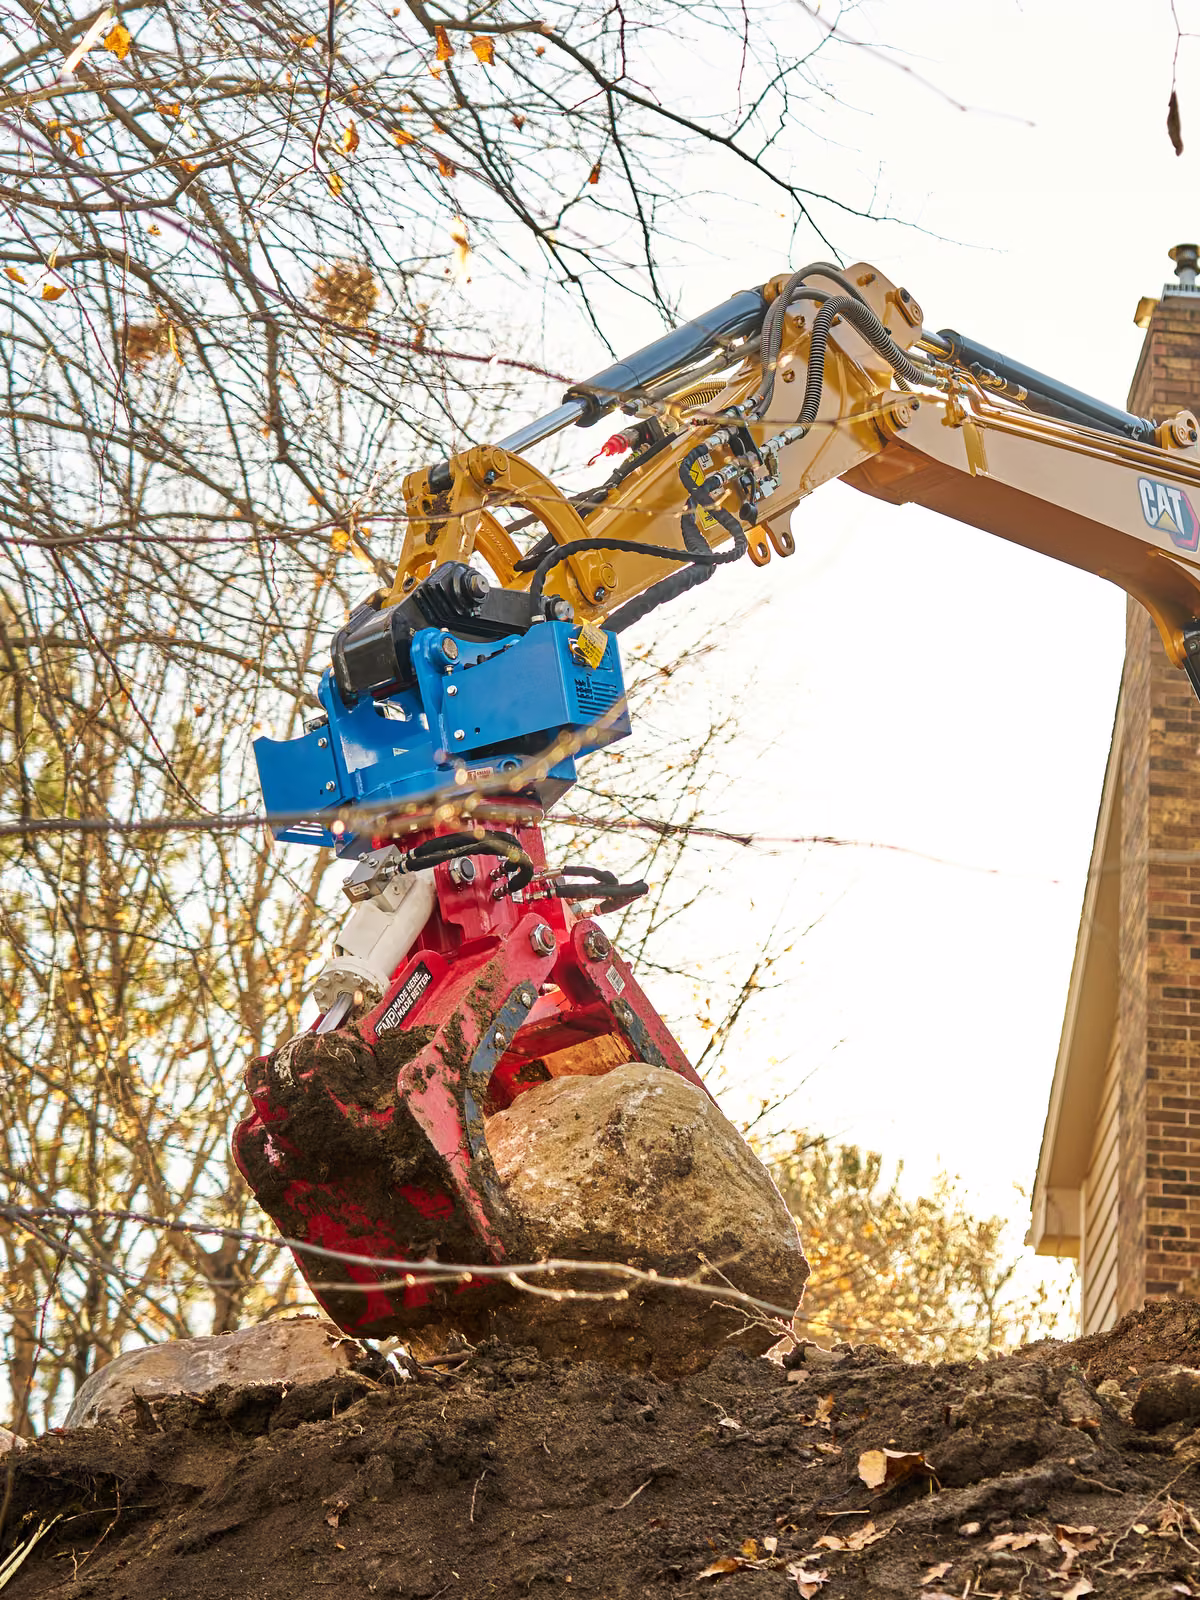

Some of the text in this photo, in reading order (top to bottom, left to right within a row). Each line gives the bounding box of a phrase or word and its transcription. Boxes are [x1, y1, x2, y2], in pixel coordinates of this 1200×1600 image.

[1139, 478, 1185, 535] CAT
[392, 972, 422, 1011] MADE HERE.
[397, 973, 432, 1019] MADE BETTER.
